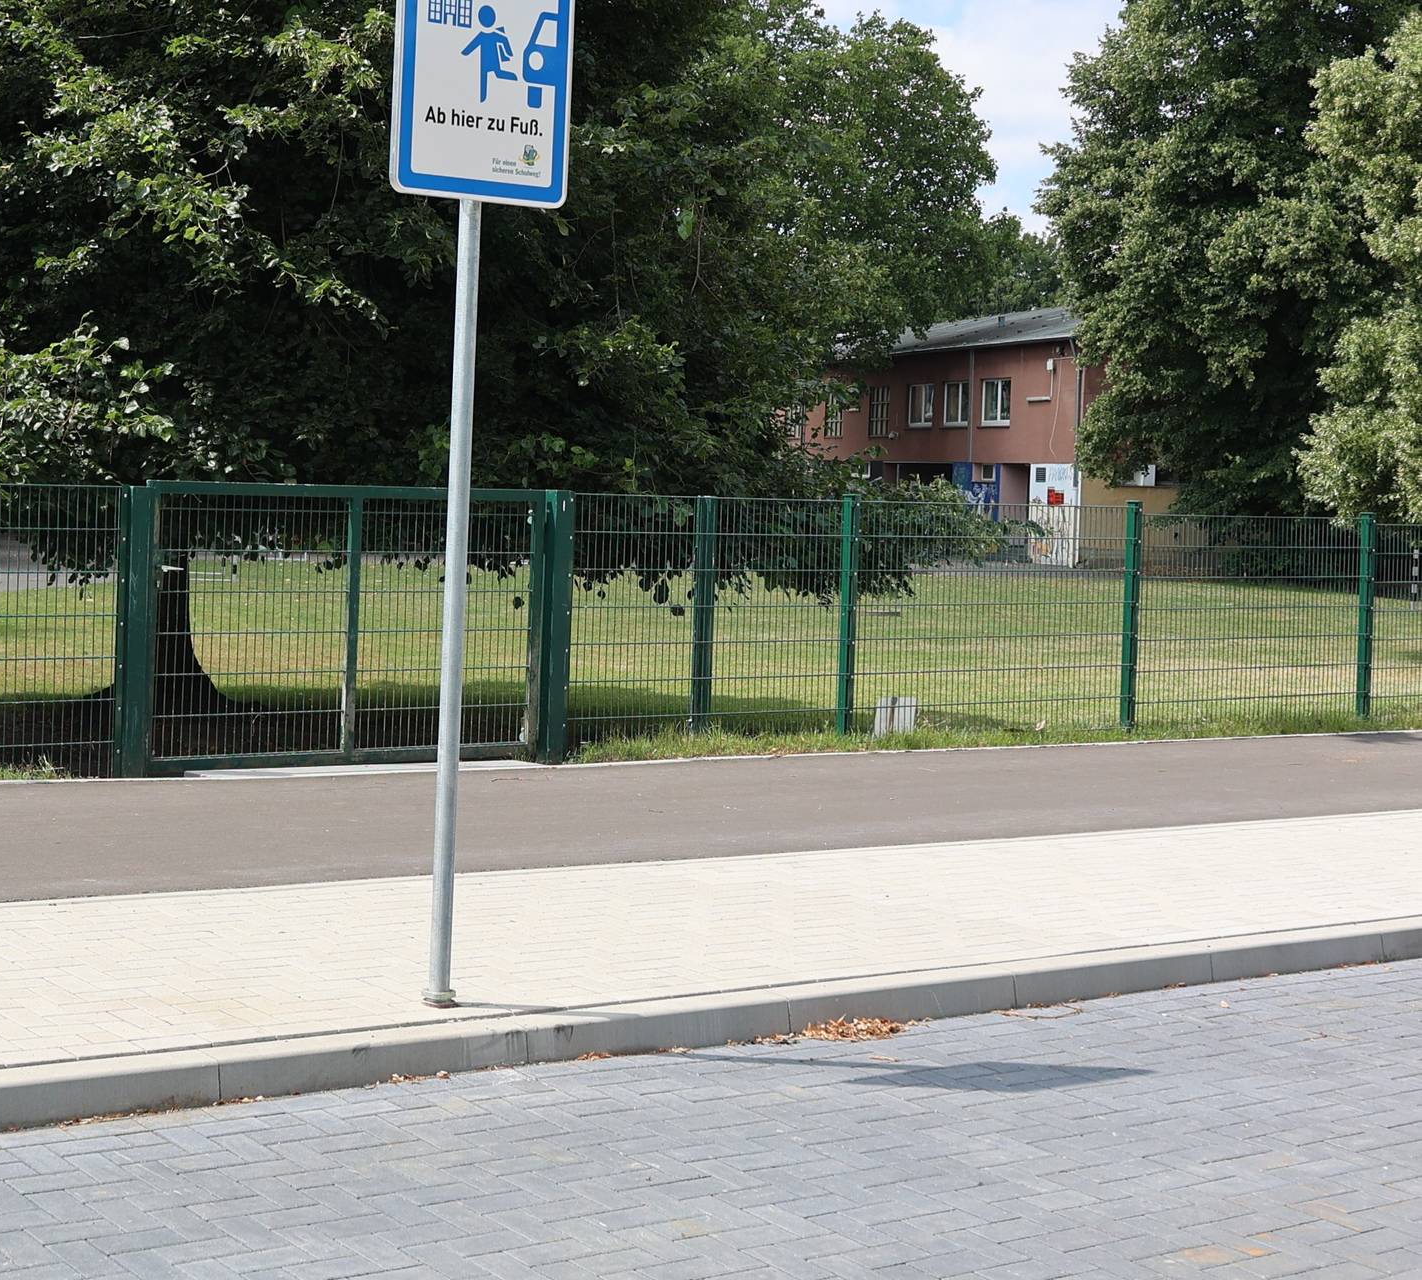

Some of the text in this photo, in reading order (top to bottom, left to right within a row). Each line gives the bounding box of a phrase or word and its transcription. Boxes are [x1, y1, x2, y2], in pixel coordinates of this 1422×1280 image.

[425, 106, 543, 137] Ab hier zu Fuß.
